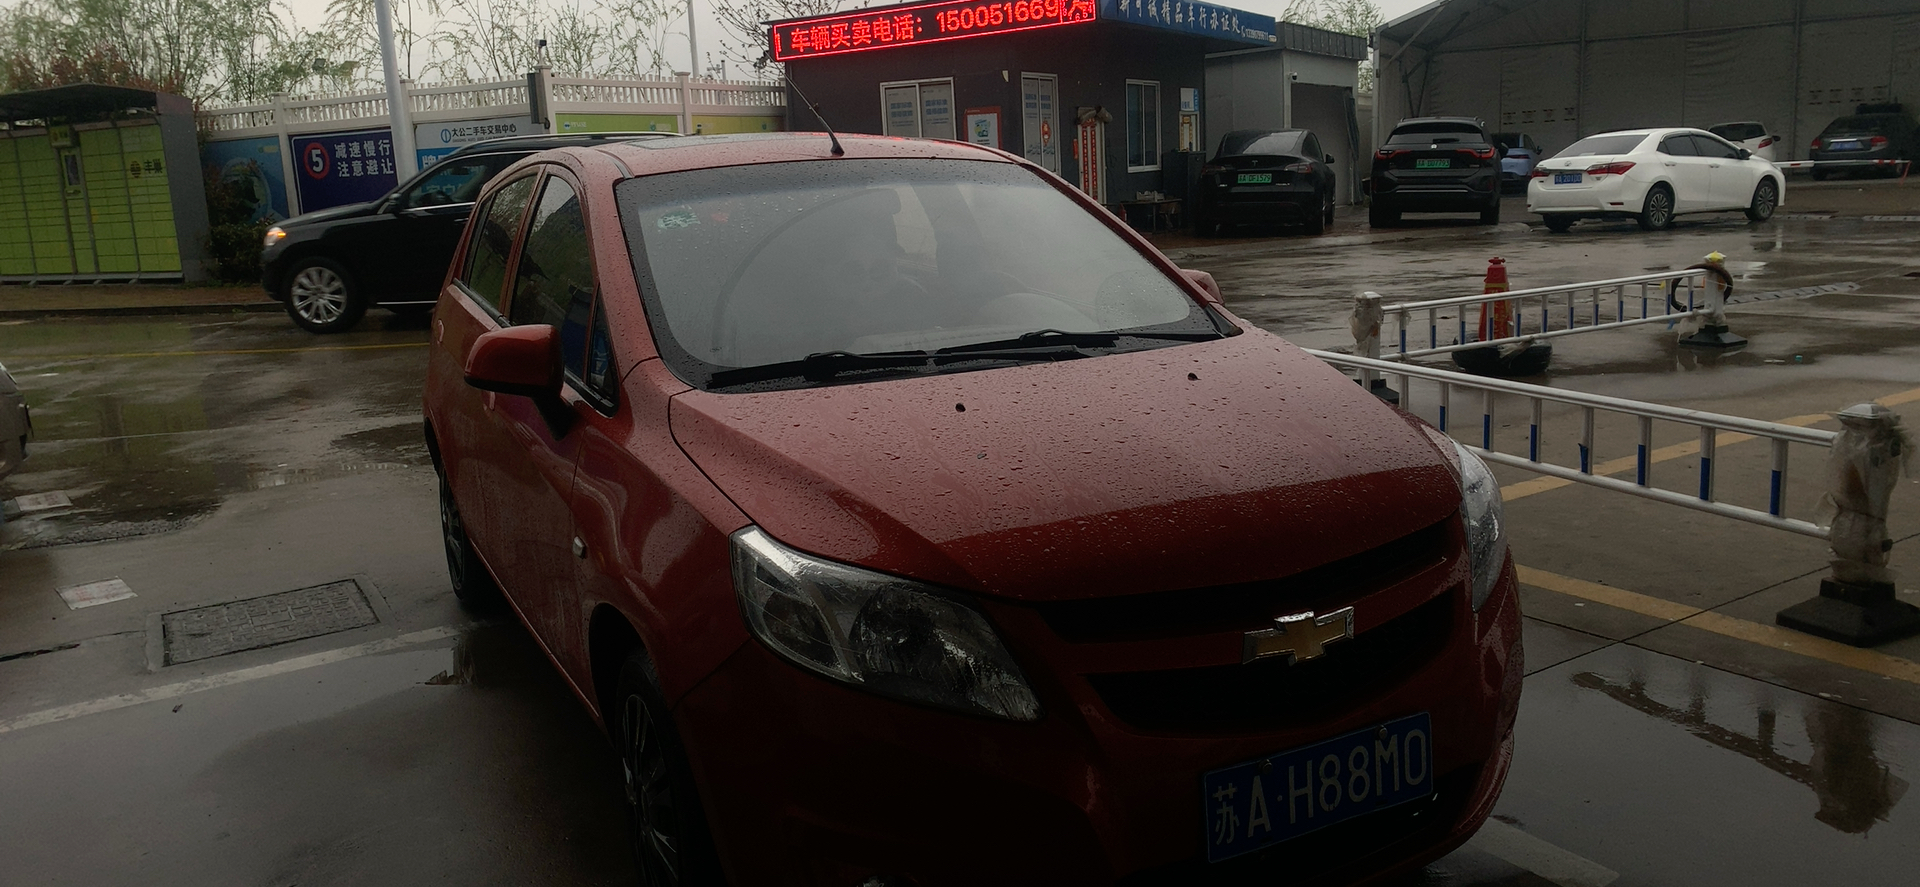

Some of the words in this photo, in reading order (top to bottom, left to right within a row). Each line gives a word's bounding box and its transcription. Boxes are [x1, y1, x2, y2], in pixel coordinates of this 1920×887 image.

[936, 0, 1059, 33] 150051669
[452, 123, 517, 138] 大公二手车交易中心
[334, 140, 391, 159] 减速慢行
[311, 149, 324, 173] 5
[337, 158, 395, 177] 注意避让
